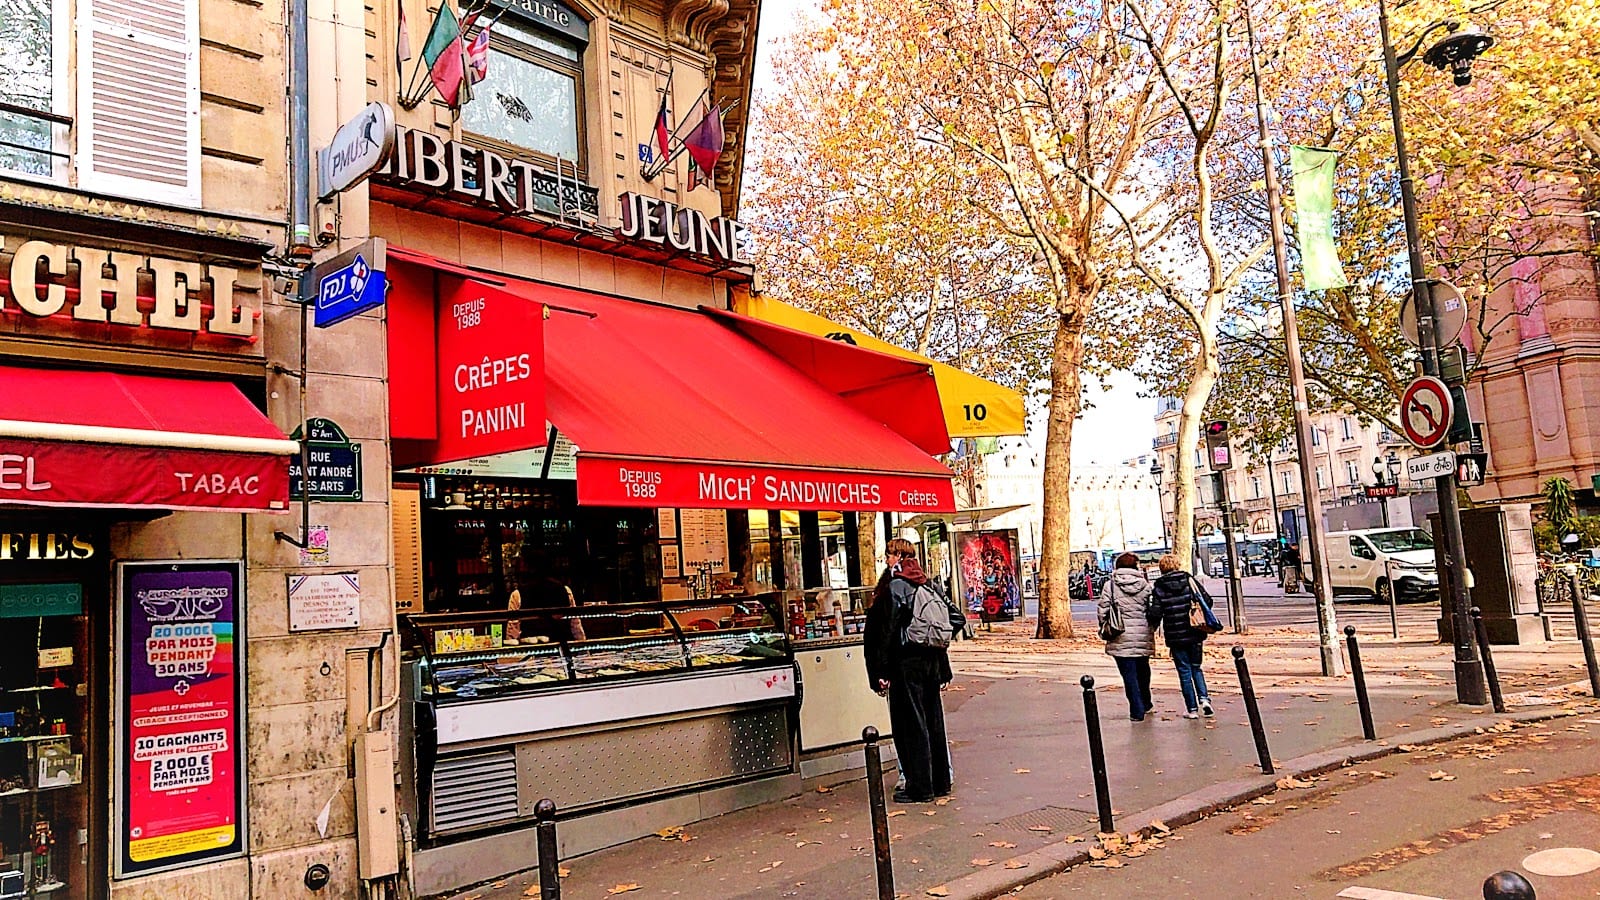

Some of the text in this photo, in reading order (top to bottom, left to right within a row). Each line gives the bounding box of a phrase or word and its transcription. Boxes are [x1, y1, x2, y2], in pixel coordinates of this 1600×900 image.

[376, 124, 751, 265] IBERT JEUNE
[0, 235, 253, 336] CHEL
[322, 274, 346, 302] FDJ
[454, 298, 485, 318] DEPUIS
[457, 312, 481, 331] 1988
[454, 354, 531, 393] CRÊPES
[963, 403, 987, 421] 10
[461, 402, 525, 439] PANINI
[310, 452, 331, 463] RUE
[289, 465, 353, 478] SANT ANDRÉ
[619, 467, 662, 485] DEPUIS
[1409, 463, 1431, 474] SAUF
[174, 472, 259, 495] TABAC
[320, 480, 344, 492] ARTS
[625, 483, 657, 498] 1988
[699, 472, 881, 505] MICH' SANDWICHES
[900, 490, 939, 506] CRÊPES
[154, 627, 171, 638] 20
[149, 637, 214, 650] PAR MOIS
[150, 649, 213, 662] PENDANT
[158, 662, 204, 674] 30 ANS
[140, 711, 223, 725] TIRAGE EXCEPTIONNEL
[138, 732, 224, 750] 10 GAGNANTS
[136, 749, 174, 759] GARANTIS
[154, 760, 162, 772] 2
[167, 756, 197, 770] 000
[153, 767, 209, 782] PAR MOIS
[153, 778, 188, 789] PENDANT
